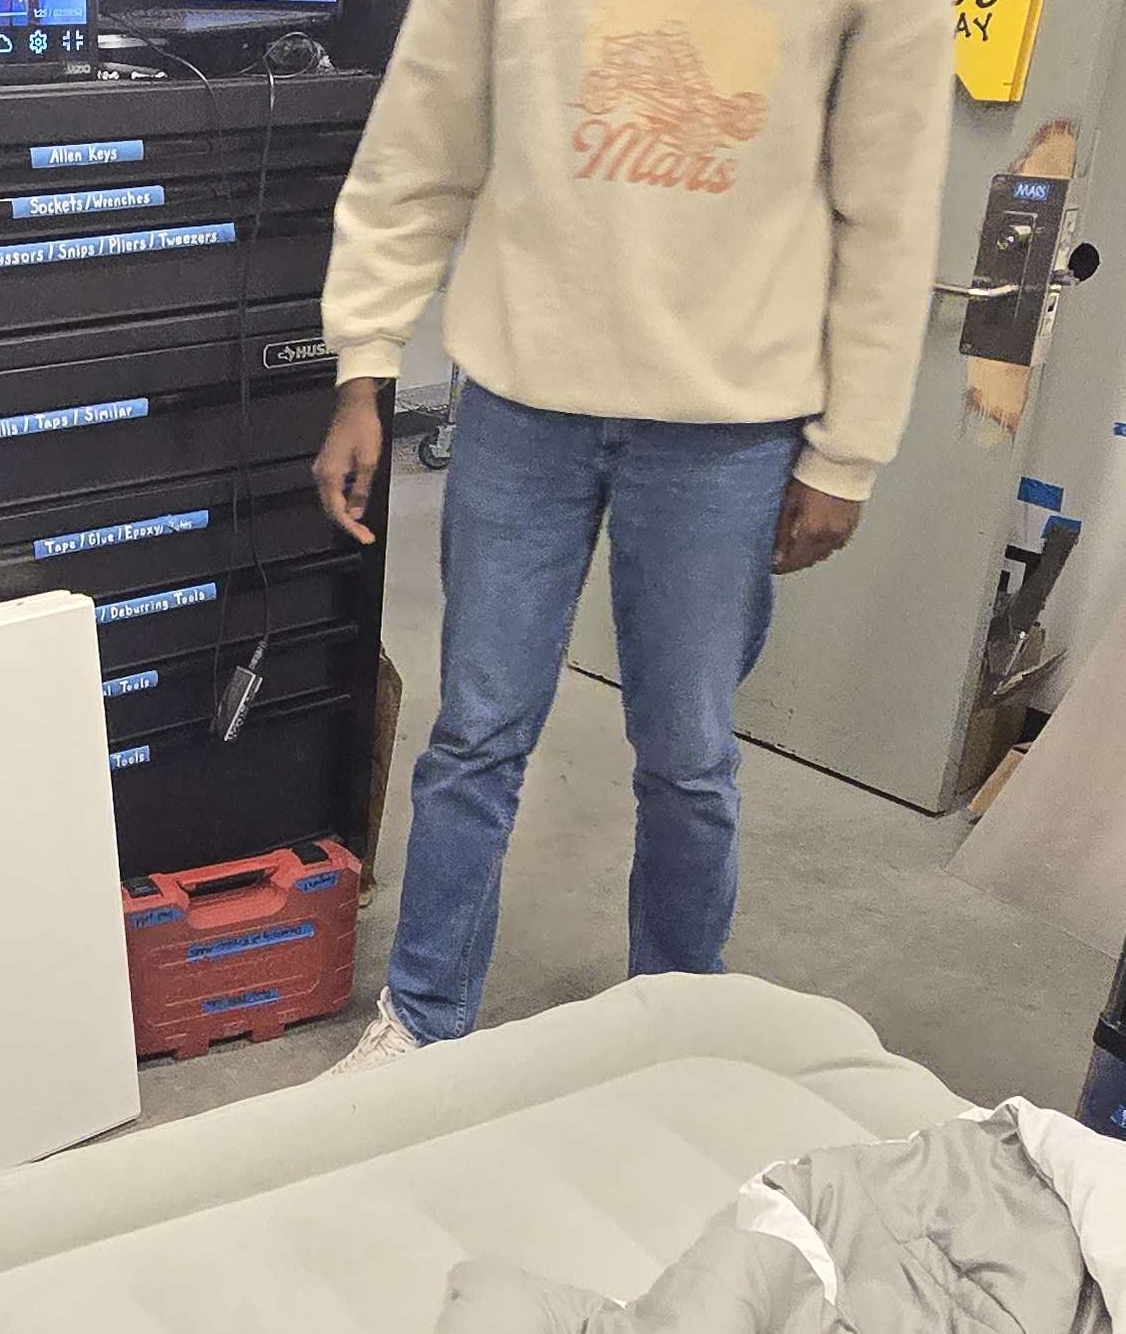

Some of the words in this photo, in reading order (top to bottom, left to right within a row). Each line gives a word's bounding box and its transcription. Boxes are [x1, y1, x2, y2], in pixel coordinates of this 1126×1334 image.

[954, 12, 993, 42] AY
[49, 147, 83, 164] Allen
[88, 144, 119, 162] Keys
[58, 243, 96, 259] Snips
[108, 236, 147, 253] Pliers
[159, 231, 218, 248] Tweezers
[295, 343, 335, 359] HUS
[34, 414, 69, 430] Taps
[84, 403, 133, 423] Similar
[44, 540, 76, 555] Tape
[88, 532, 115, 546] Glue
[110, 600, 169, 620] Deburring
[174, 591, 206, 607] Tools
[119, 678, 150, 693] Tools
[112, 748, 146, 768] Tools
